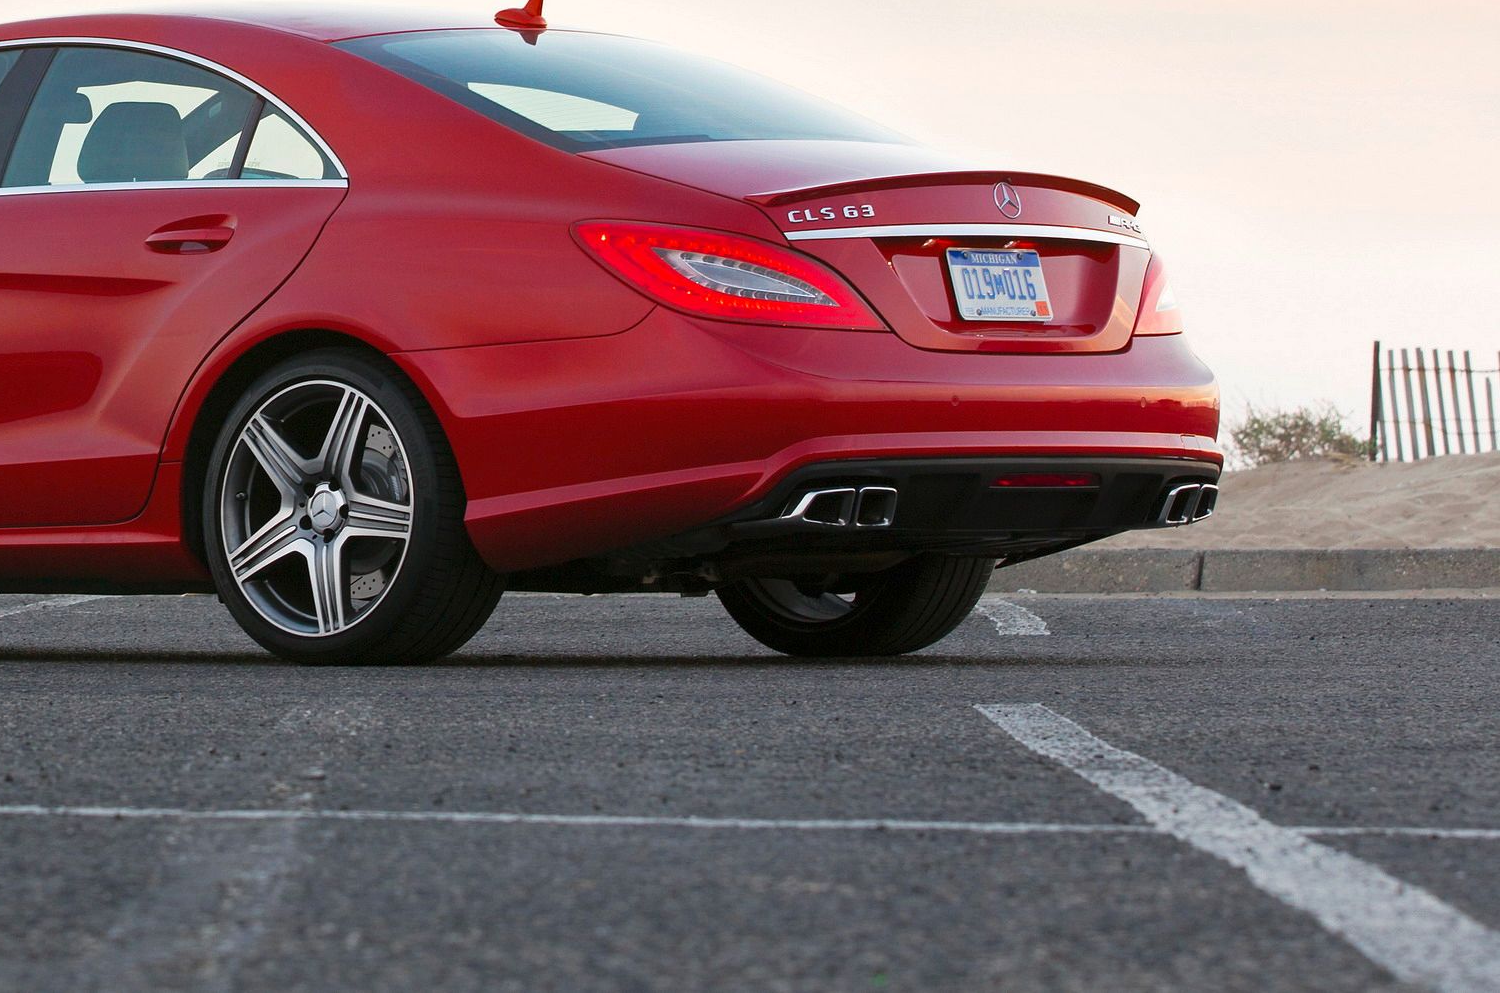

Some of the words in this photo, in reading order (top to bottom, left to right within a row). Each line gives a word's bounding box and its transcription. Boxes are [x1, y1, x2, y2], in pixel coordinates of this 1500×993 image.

[787, 206, 837, 223] CLS
[842, 204, 876, 219] 63
[971, 252, 1018, 265] MICHIGAN
[961, 268, 1037, 301] 019M016
